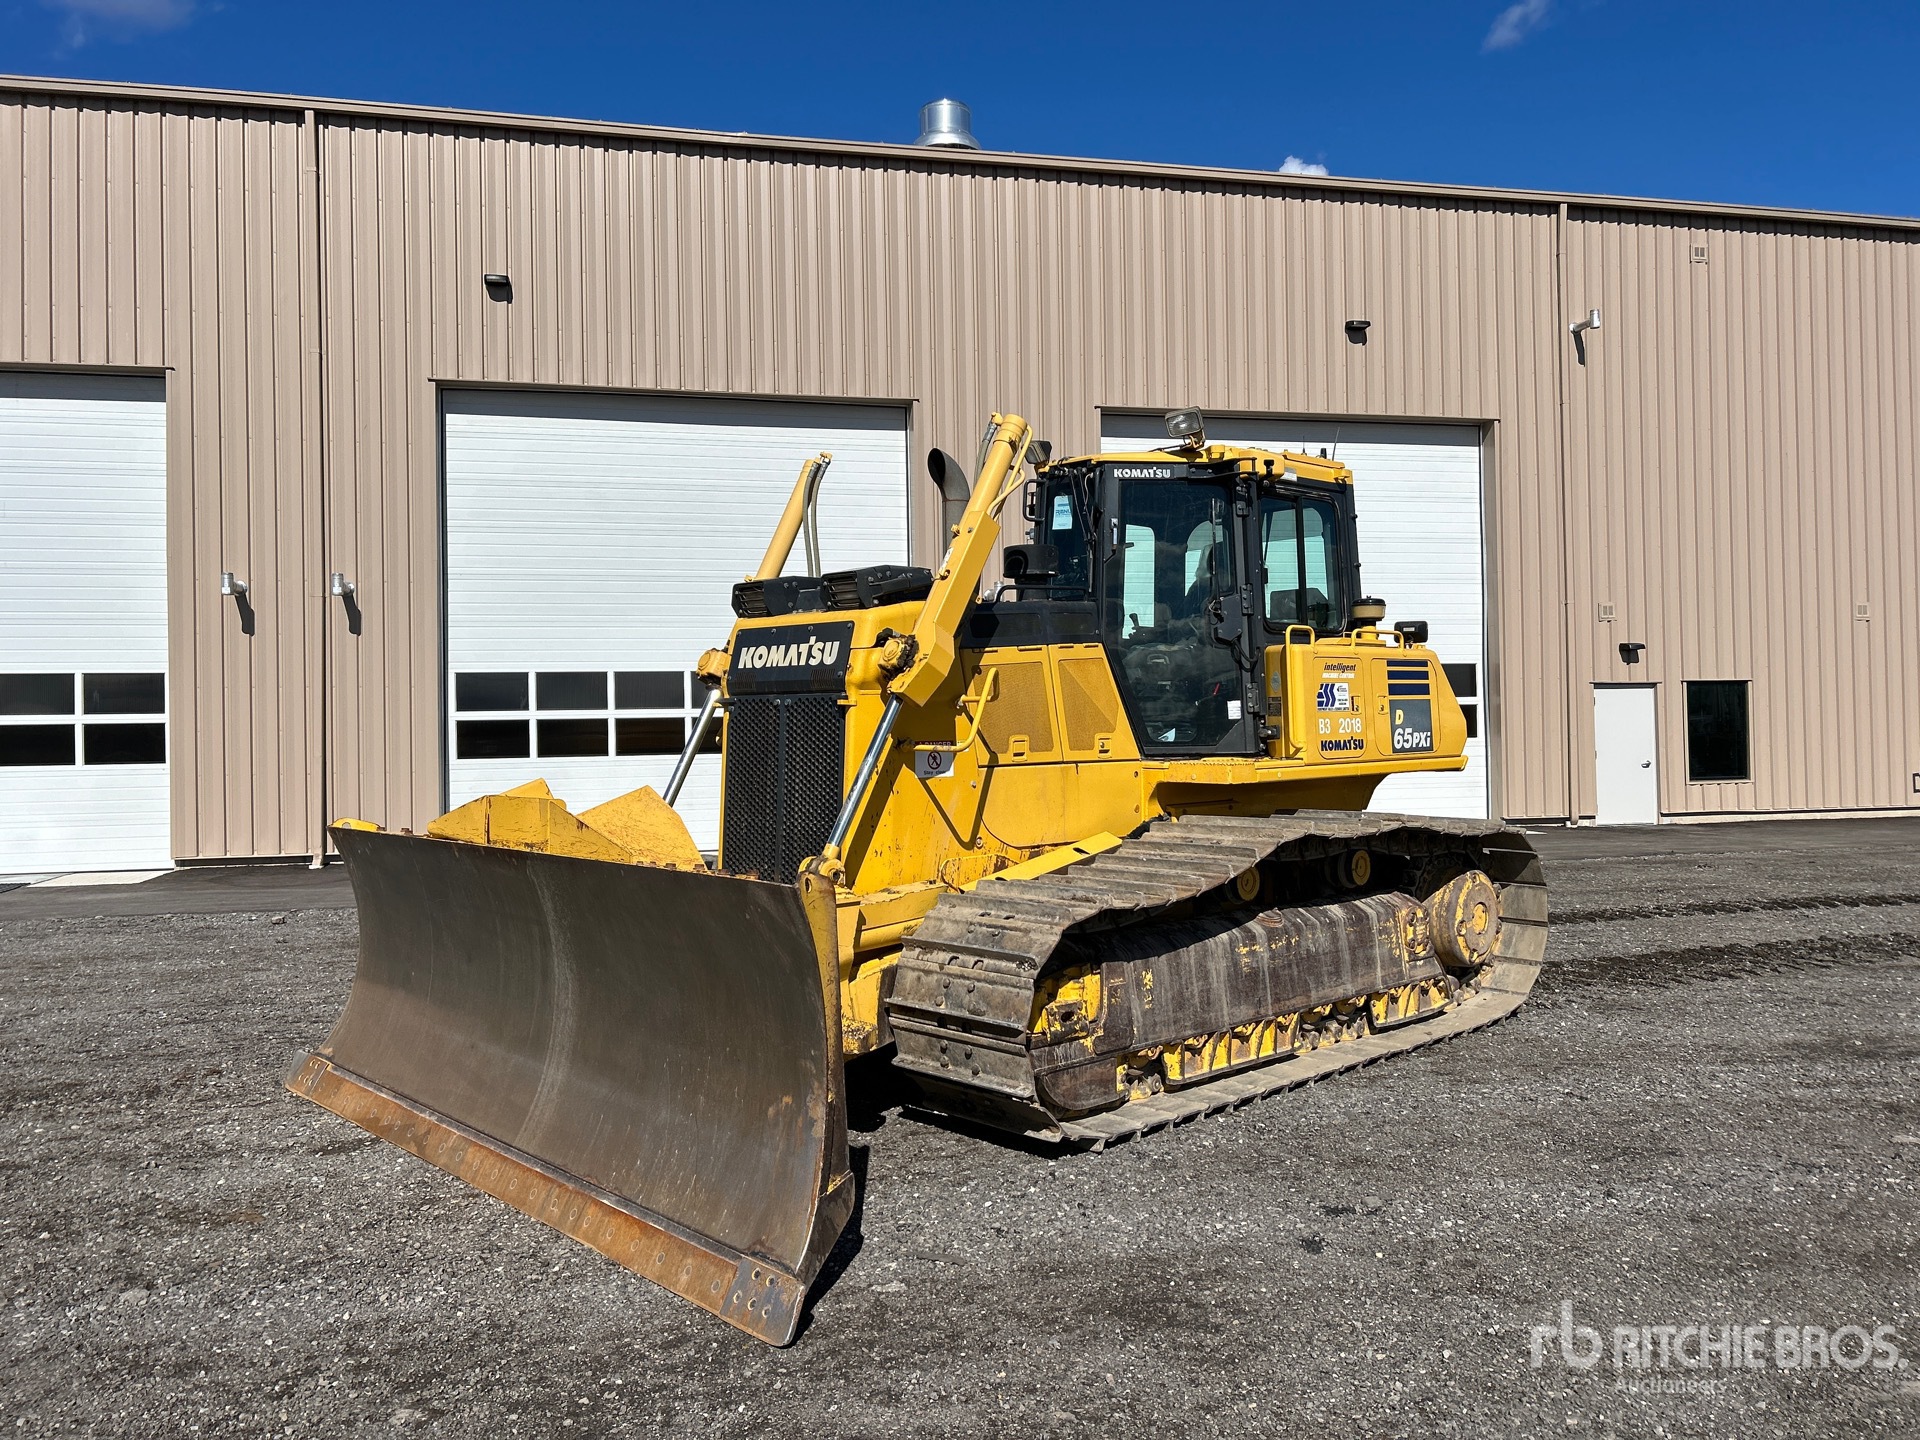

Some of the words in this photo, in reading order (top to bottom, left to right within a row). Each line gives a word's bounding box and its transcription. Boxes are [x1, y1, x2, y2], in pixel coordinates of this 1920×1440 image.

[1113, 466, 1171, 479] KOMATSU
[738, 635, 840, 669] KOMATSU
[1323, 662, 1357, 674] intelligent
[1395, 709, 1404, 725] D
[1318, 718, 1331, 734] B3
[1338, 717, 1362, 734] 2018
[1320, 736, 1364, 752] KOMATSU
[1393, 727, 1431, 749] 65PXi
